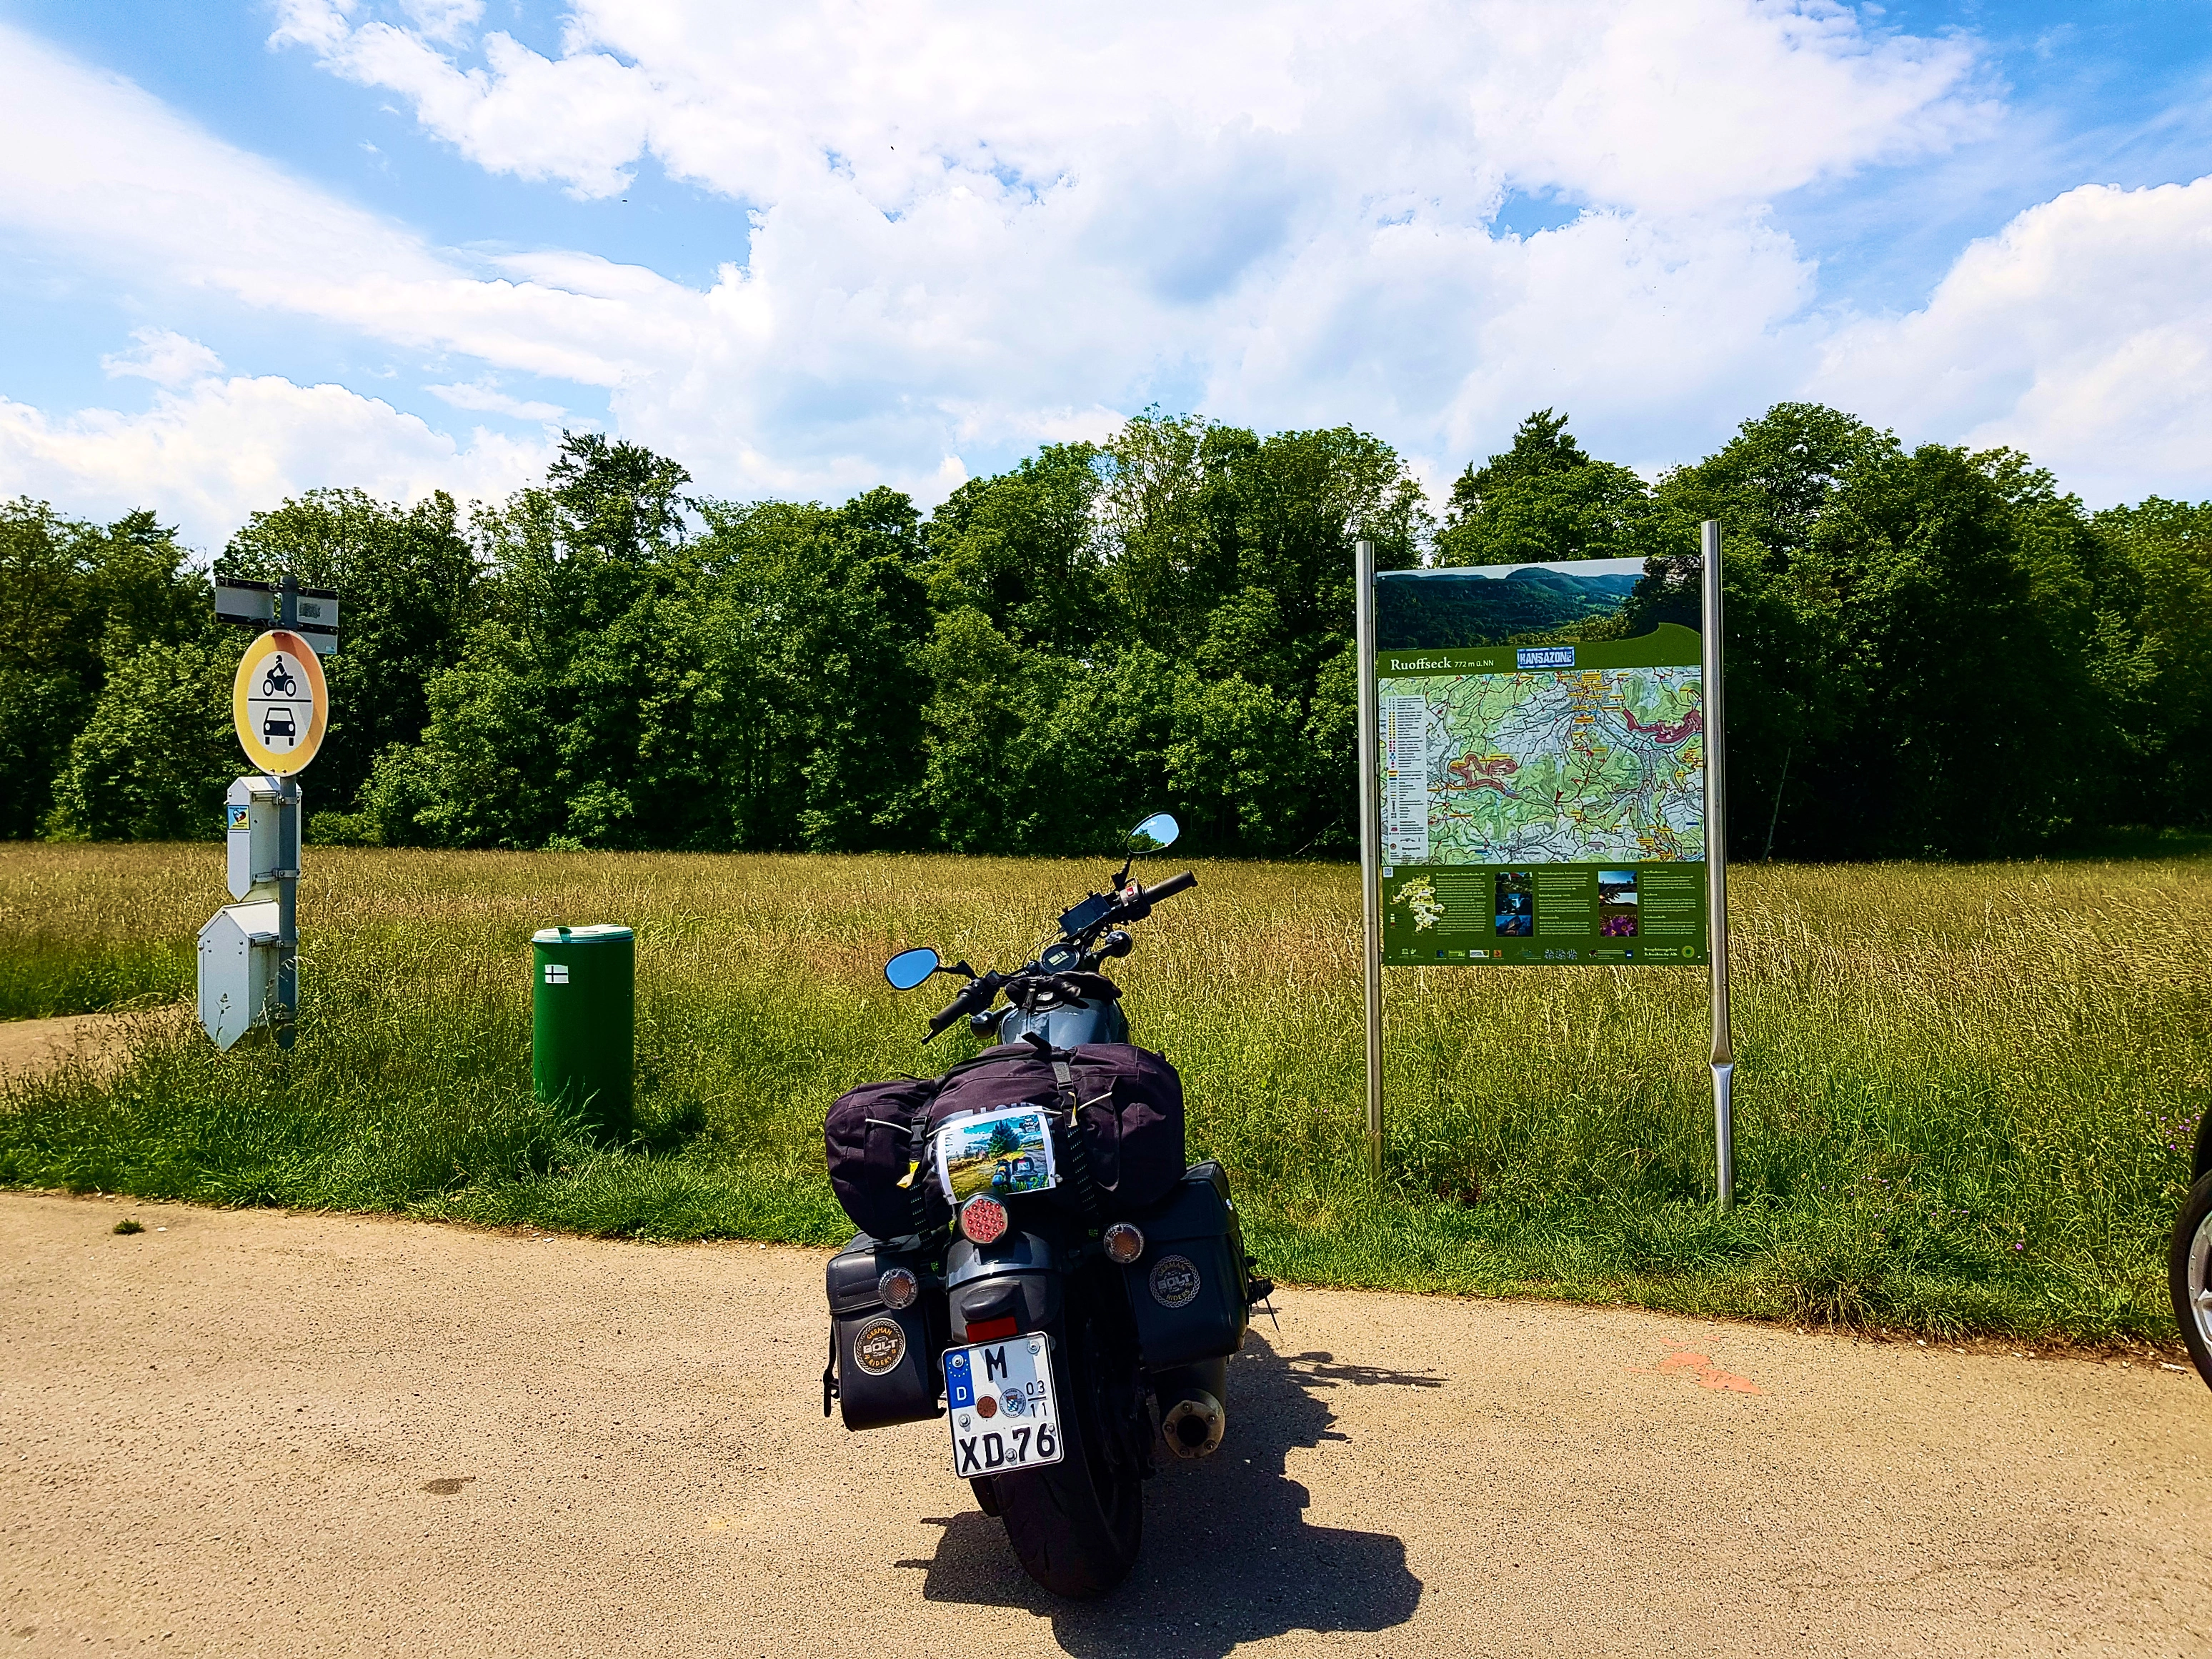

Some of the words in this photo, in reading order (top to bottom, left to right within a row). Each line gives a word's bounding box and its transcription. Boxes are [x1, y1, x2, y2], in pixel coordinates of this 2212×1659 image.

[1390, 656, 1452, 670] Ruoffseck
[1520, 651, 1573, 664] HANSAZONE
[1157, 1272, 1191, 1290] BOLT
[1166, 1288, 1190, 1301] RIDERS
[867, 1327, 892, 1340] GERMAN
[863, 1338, 898, 1354] BOLT
[868, 1356, 892, 1366] RIDERS
[985, 1345, 1008, 1382] M
[956, 1386, 967, 1401] D
[1026, 1380, 1045, 1395] 03
[1030, 1402, 1047, 1418] 11
